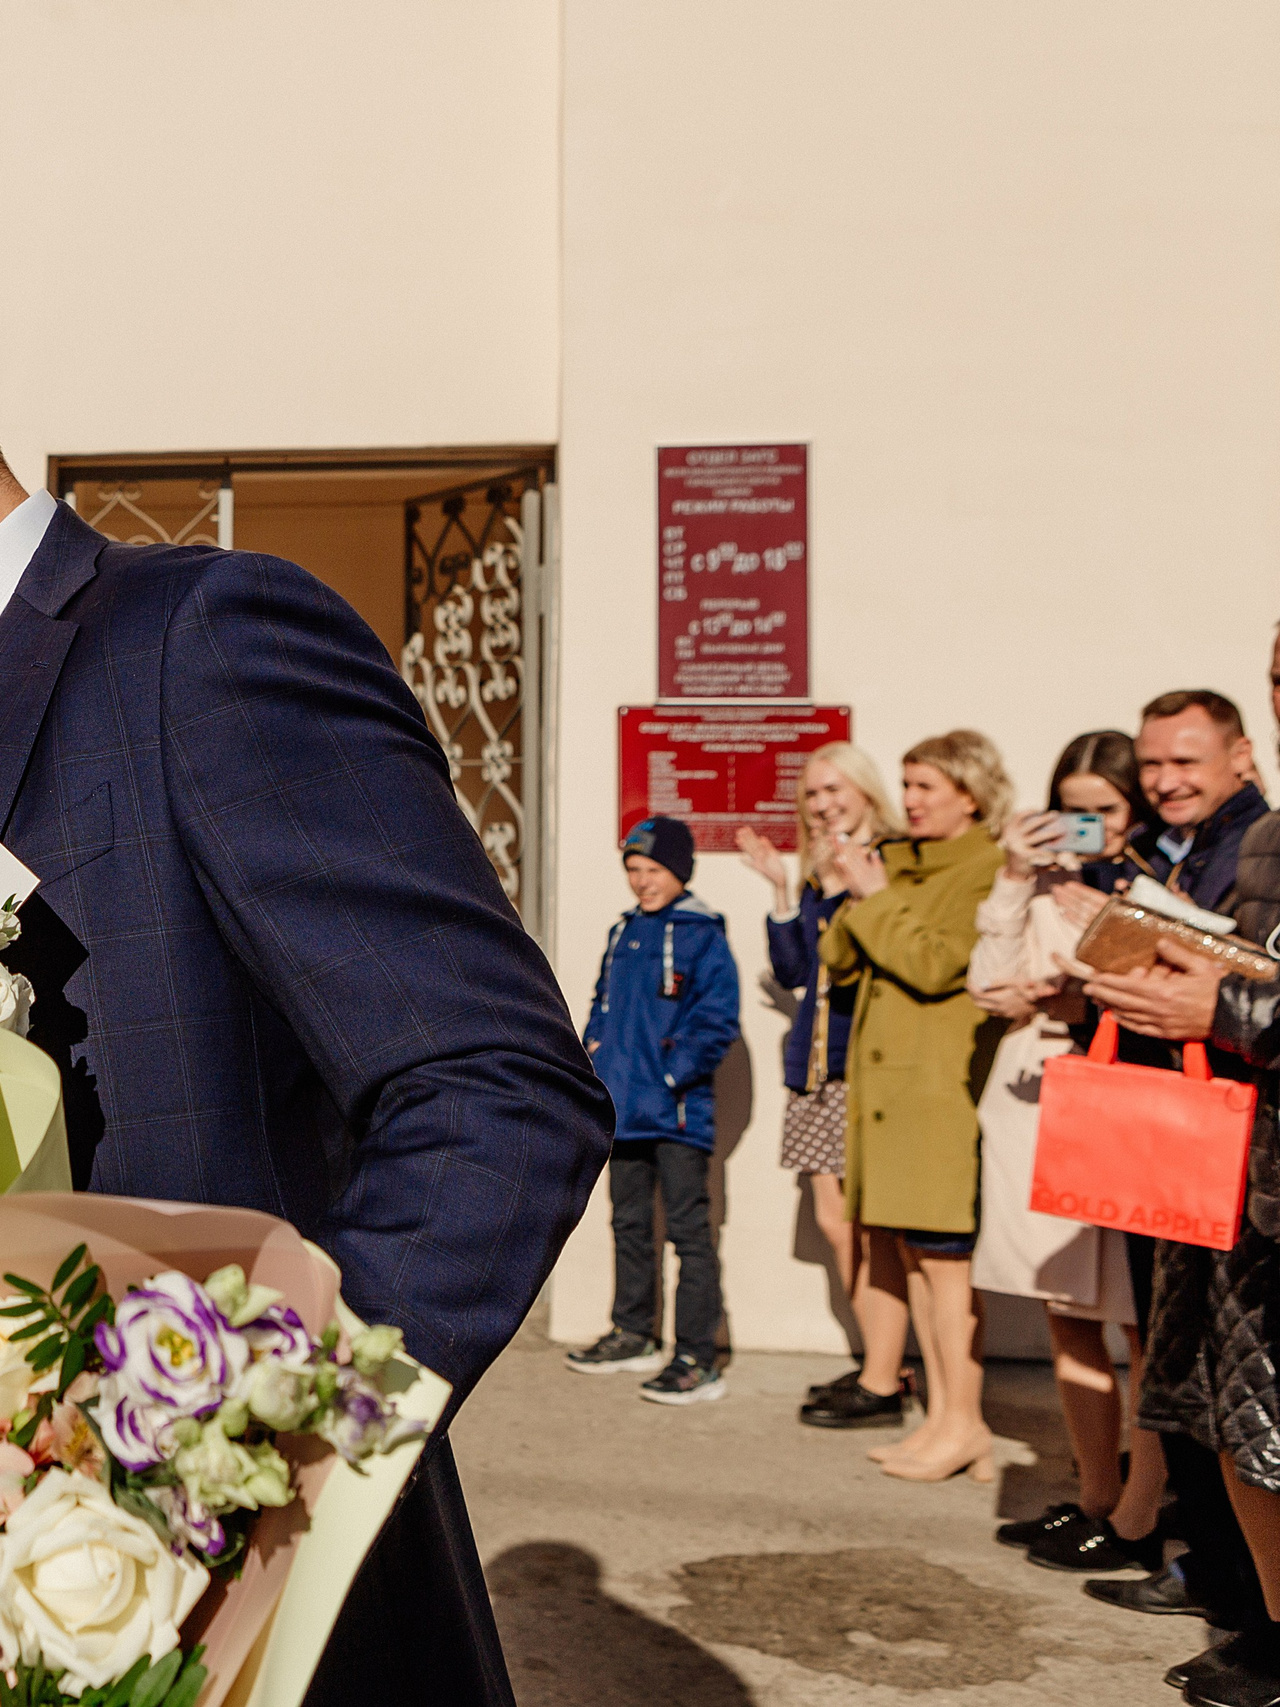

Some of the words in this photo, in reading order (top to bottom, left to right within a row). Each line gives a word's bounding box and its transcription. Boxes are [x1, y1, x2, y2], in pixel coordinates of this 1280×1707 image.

[672, 500, 727, 515] РЕЖИМ
[729, 498, 795, 514] РАБОТЫ
[1032, 1188, 1120, 1222] GOLD
[1127, 1204, 1230, 1243] APPLE
